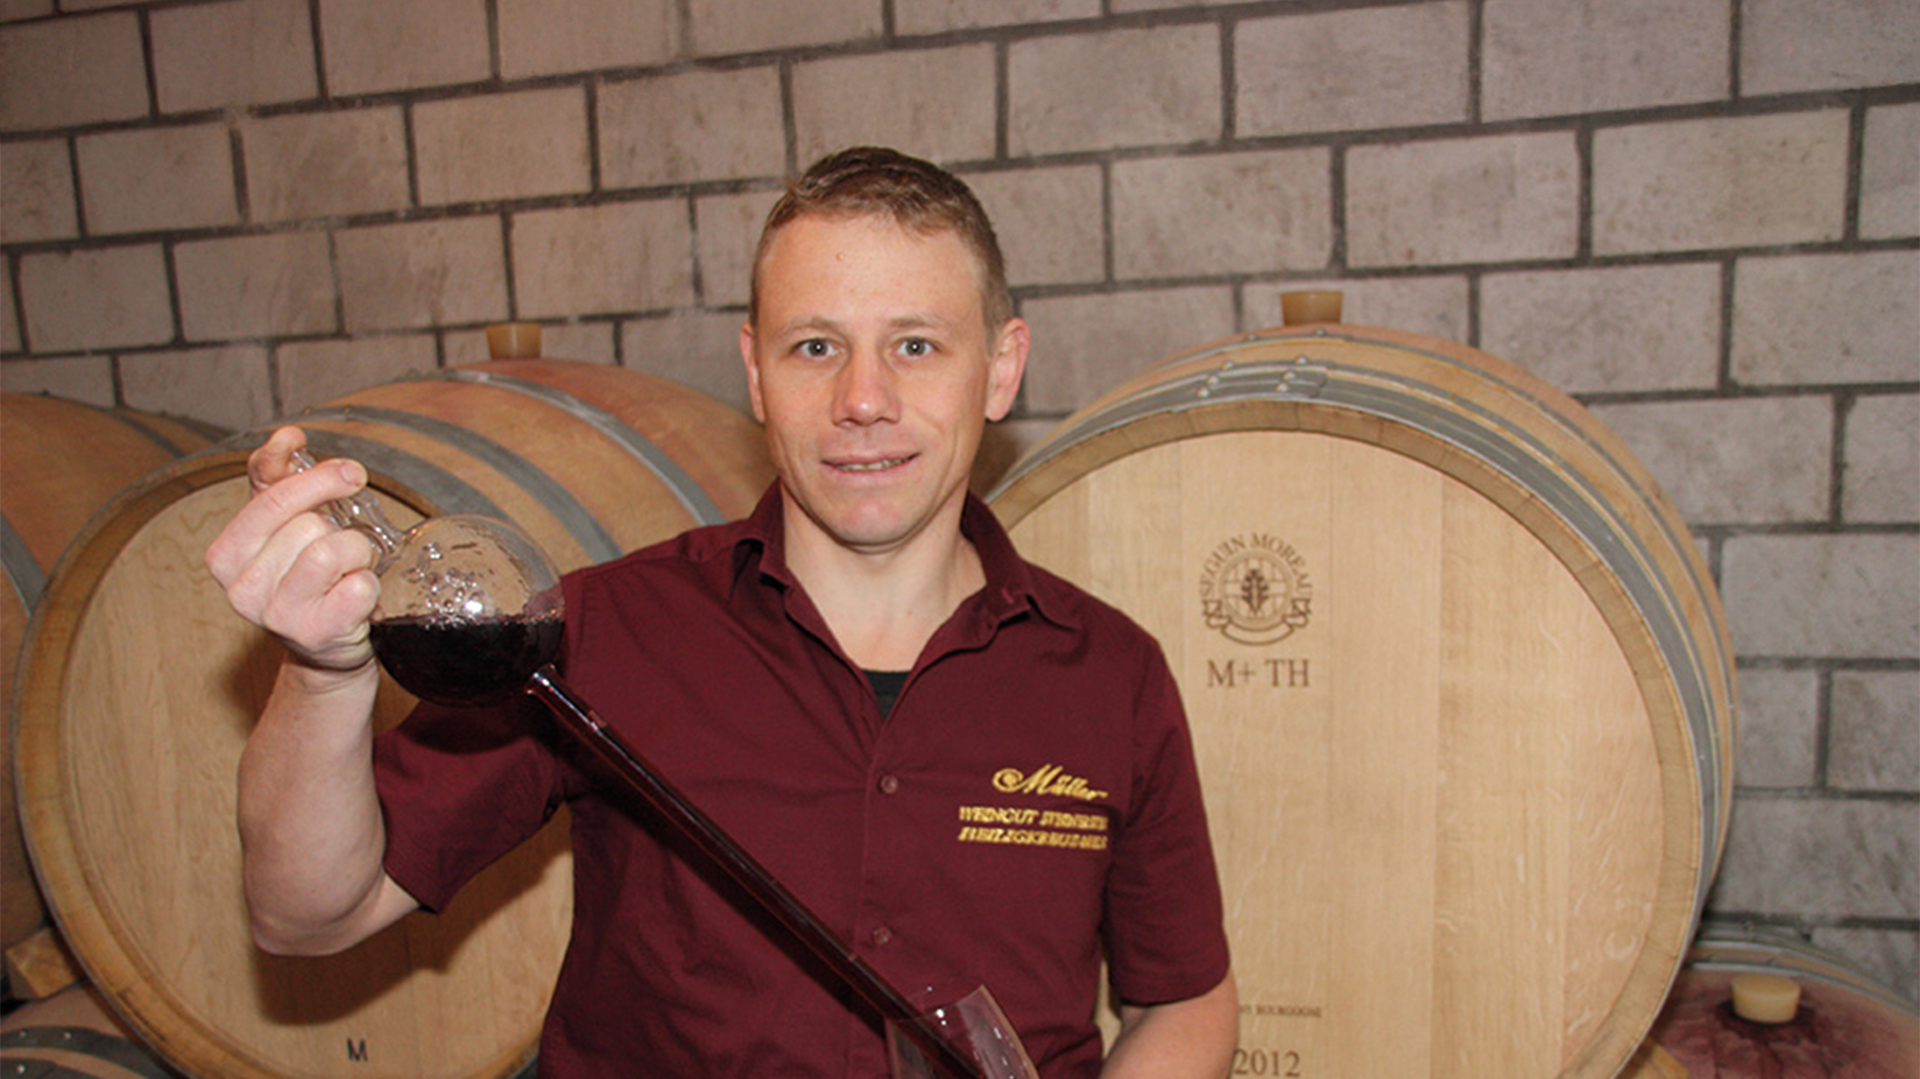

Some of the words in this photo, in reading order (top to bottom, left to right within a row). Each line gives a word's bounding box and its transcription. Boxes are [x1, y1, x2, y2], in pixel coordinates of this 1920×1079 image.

[1200, 534, 1246, 597] SEGUIN
[1264, 658, 1310, 688] TH
[992, 763, 1109, 800] Müller
[959, 806, 1039, 825] WEINGUT
[347, 1037, 368, 1062] M
[1233, 1048, 1301, 1078] 2012
